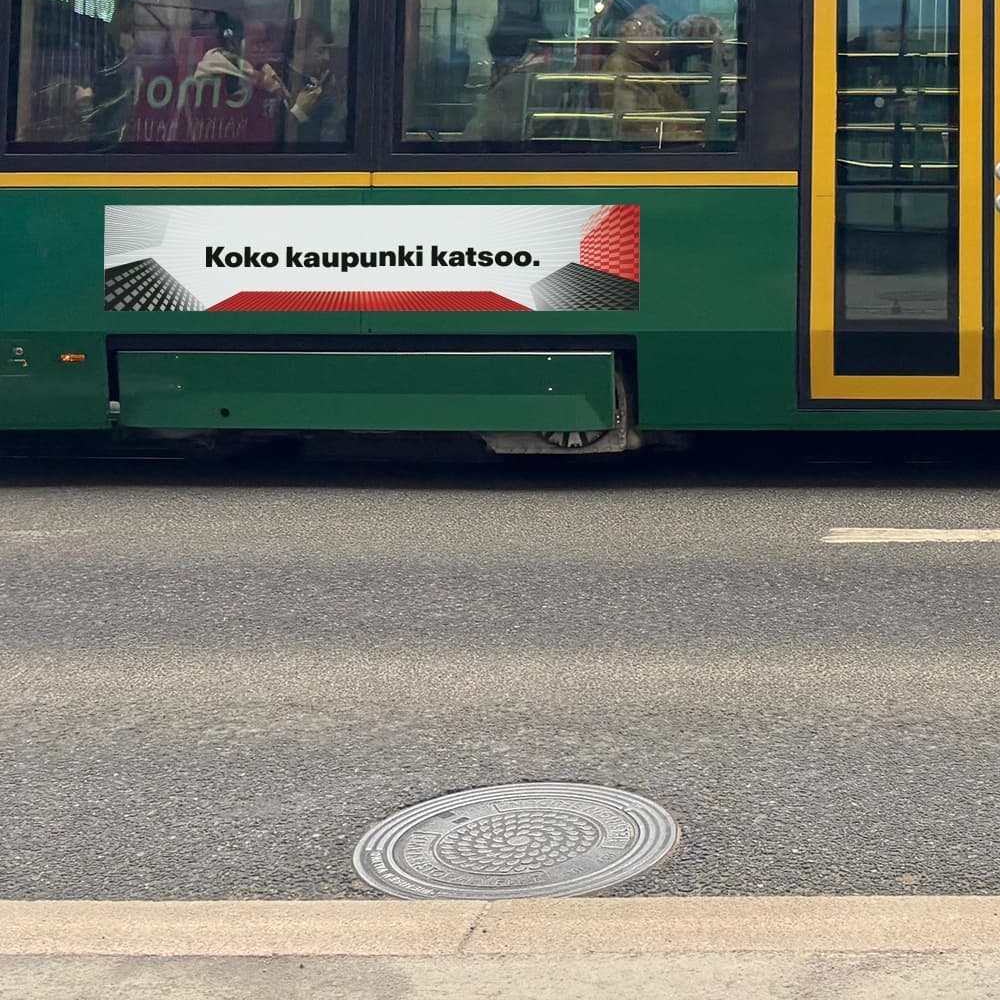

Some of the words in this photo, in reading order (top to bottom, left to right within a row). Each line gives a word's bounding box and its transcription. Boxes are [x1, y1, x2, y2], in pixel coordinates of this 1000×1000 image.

[205, 246, 279, 268] Koko
[286, 245, 423, 272] kaupunki
[431, 245, 540, 267] katsoo.
